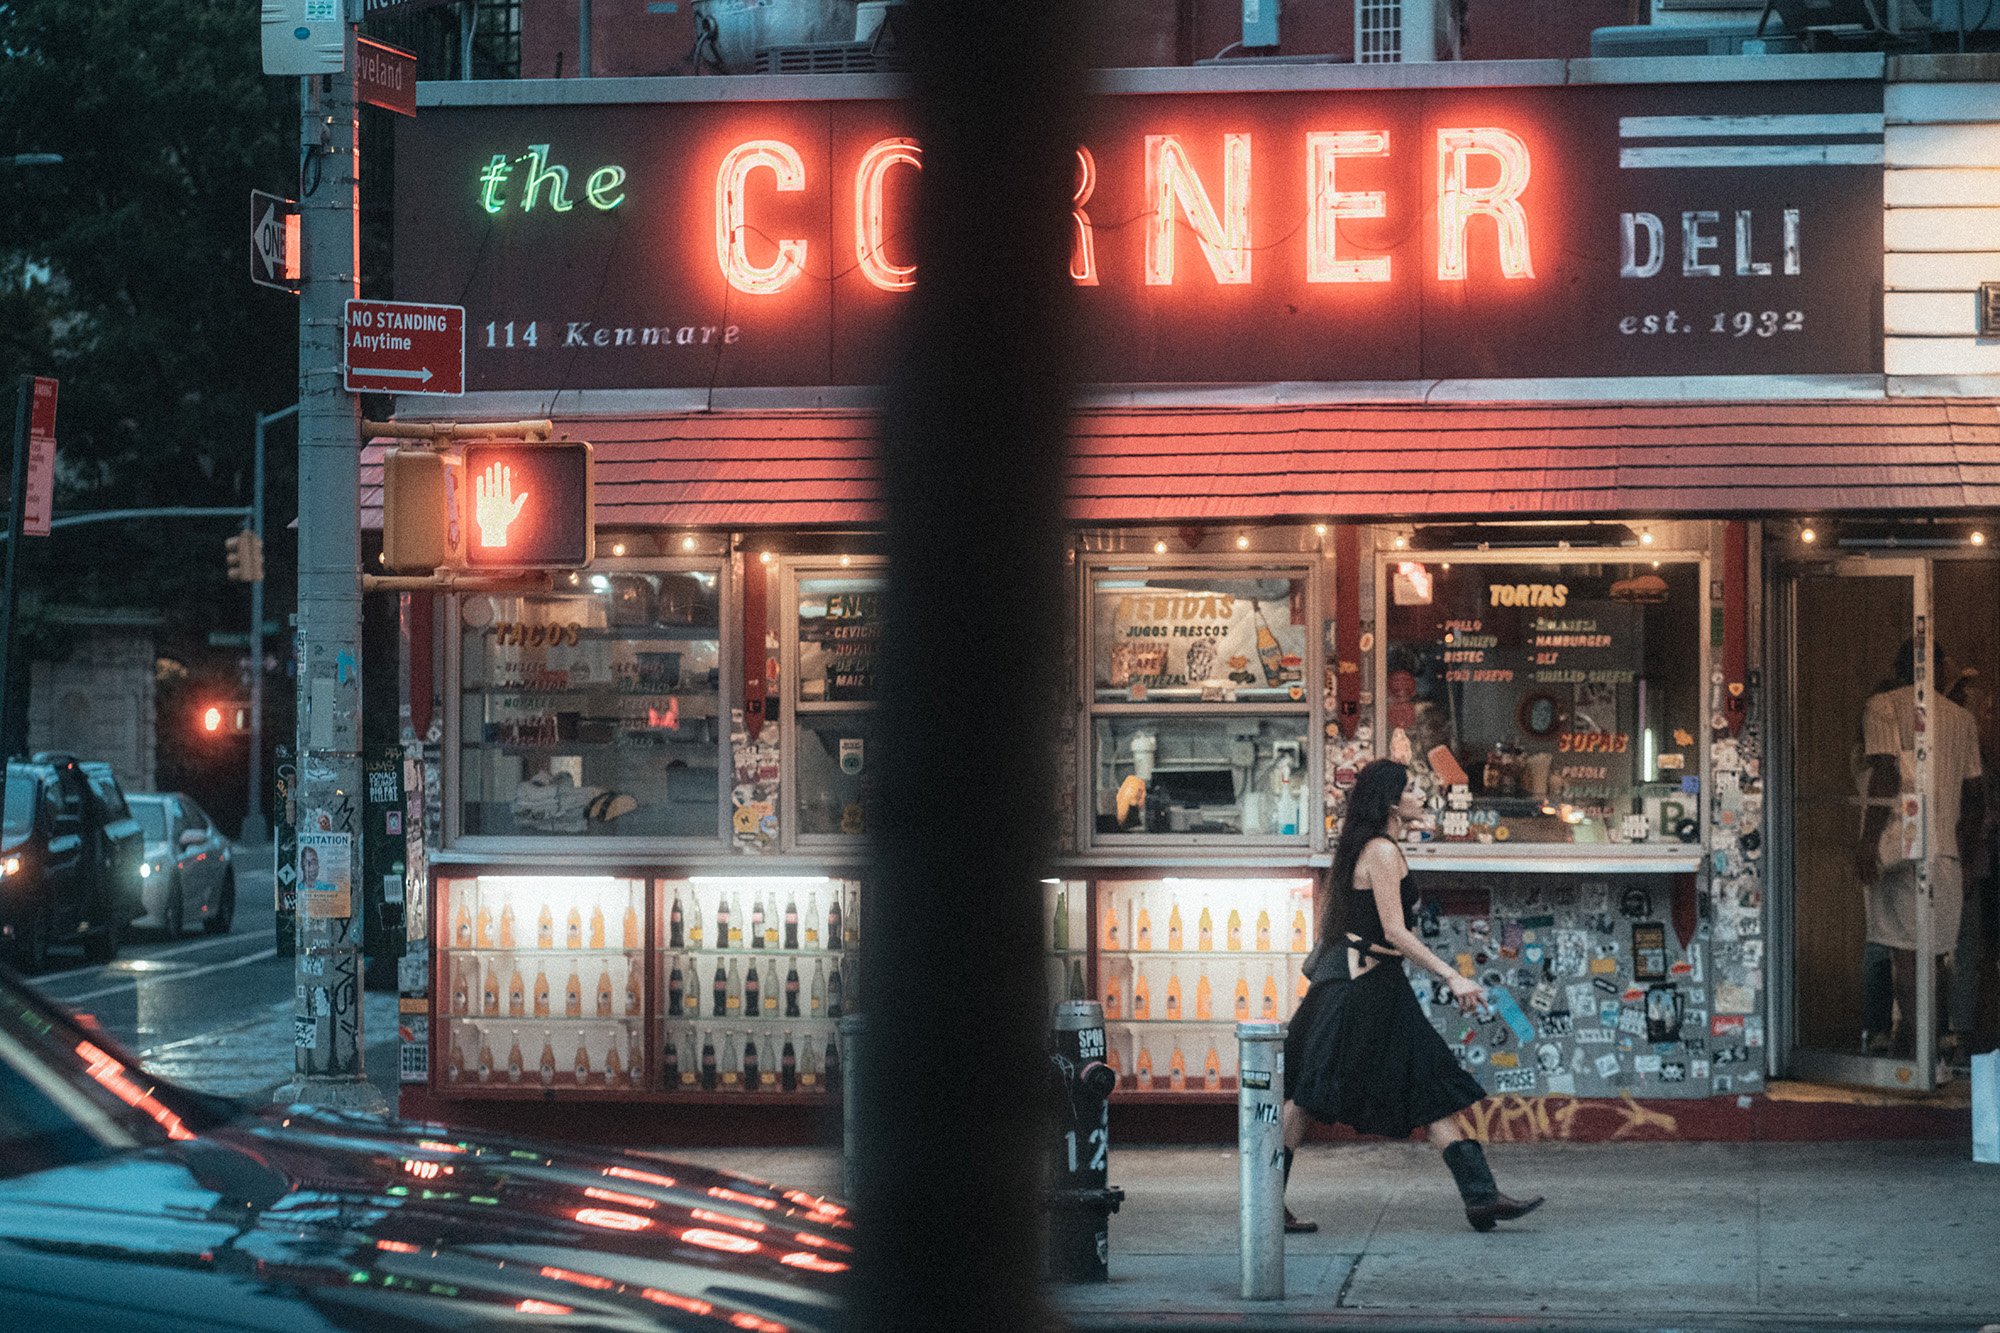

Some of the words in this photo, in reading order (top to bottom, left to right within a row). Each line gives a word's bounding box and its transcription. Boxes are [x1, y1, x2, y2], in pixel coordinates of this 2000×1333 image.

[478, 143, 627, 214] the
[1619, 208, 1801, 279] DELI
[352, 310, 373, 328] NO
[376, 311, 448, 332] STANDING
[1618, 310, 1692, 334] est.
[1710, 310, 1805, 338] 1932
[352, 331, 412, 352] Anytime
[485, 321, 539, 348] 114
[562, 320, 741, 348] Kenmare
[1489, 583, 1569, 608] TORTAS
[495, 620, 582, 646] TACOS
[1126, 625, 1168, 638] JUGOS
[1172, 625, 1229, 638] FRESCOS
[1535, 634, 1612, 648] HAMBURGER
[1443, 650, 1484, 663] BISTEC
[1558, 731, 1629, 753] SOPAS
